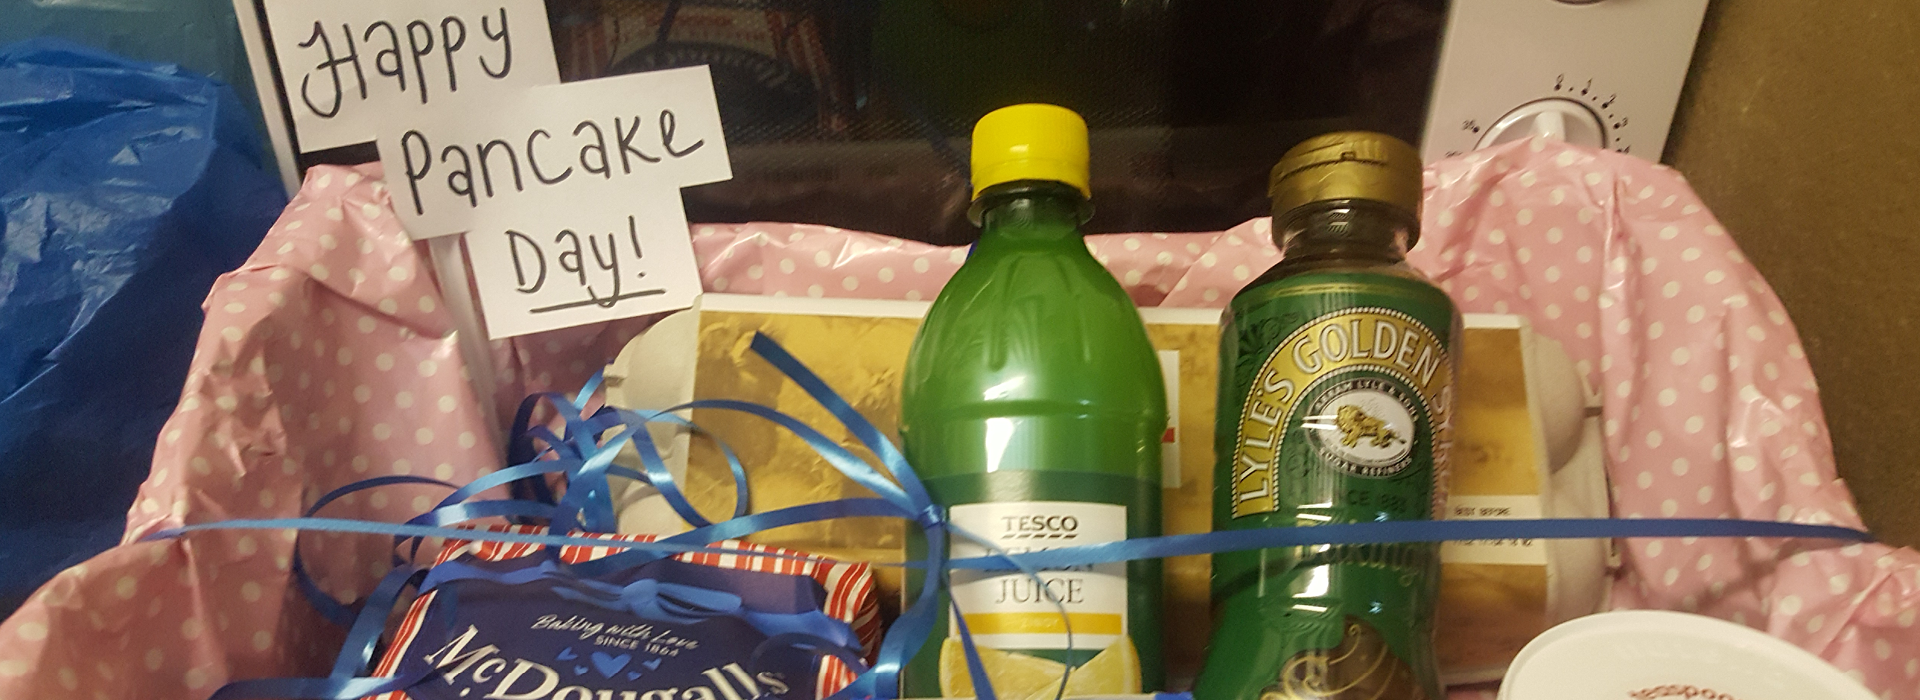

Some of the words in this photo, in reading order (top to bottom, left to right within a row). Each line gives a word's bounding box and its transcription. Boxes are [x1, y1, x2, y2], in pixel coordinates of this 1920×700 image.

[299, 7, 512, 118] Happy
[400, 109, 704, 215] Pancake
[505, 216, 648, 308] Day!
[1238, 368, 1297, 504] LYLE'S
[1292, 319, 1441, 388] GOLDEN
[1001, 515, 1079, 533] TESCO
[996, 577, 1085, 604] JUICE
[530, 613, 605, 641] Baking
[604, 623, 654, 641] with
[649, 629, 700, 650] Love
[593, 634, 641, 651] SINCE
[644, 641, 681, 658] 1864
[1629, 684, 1742, 700] teaspoo
